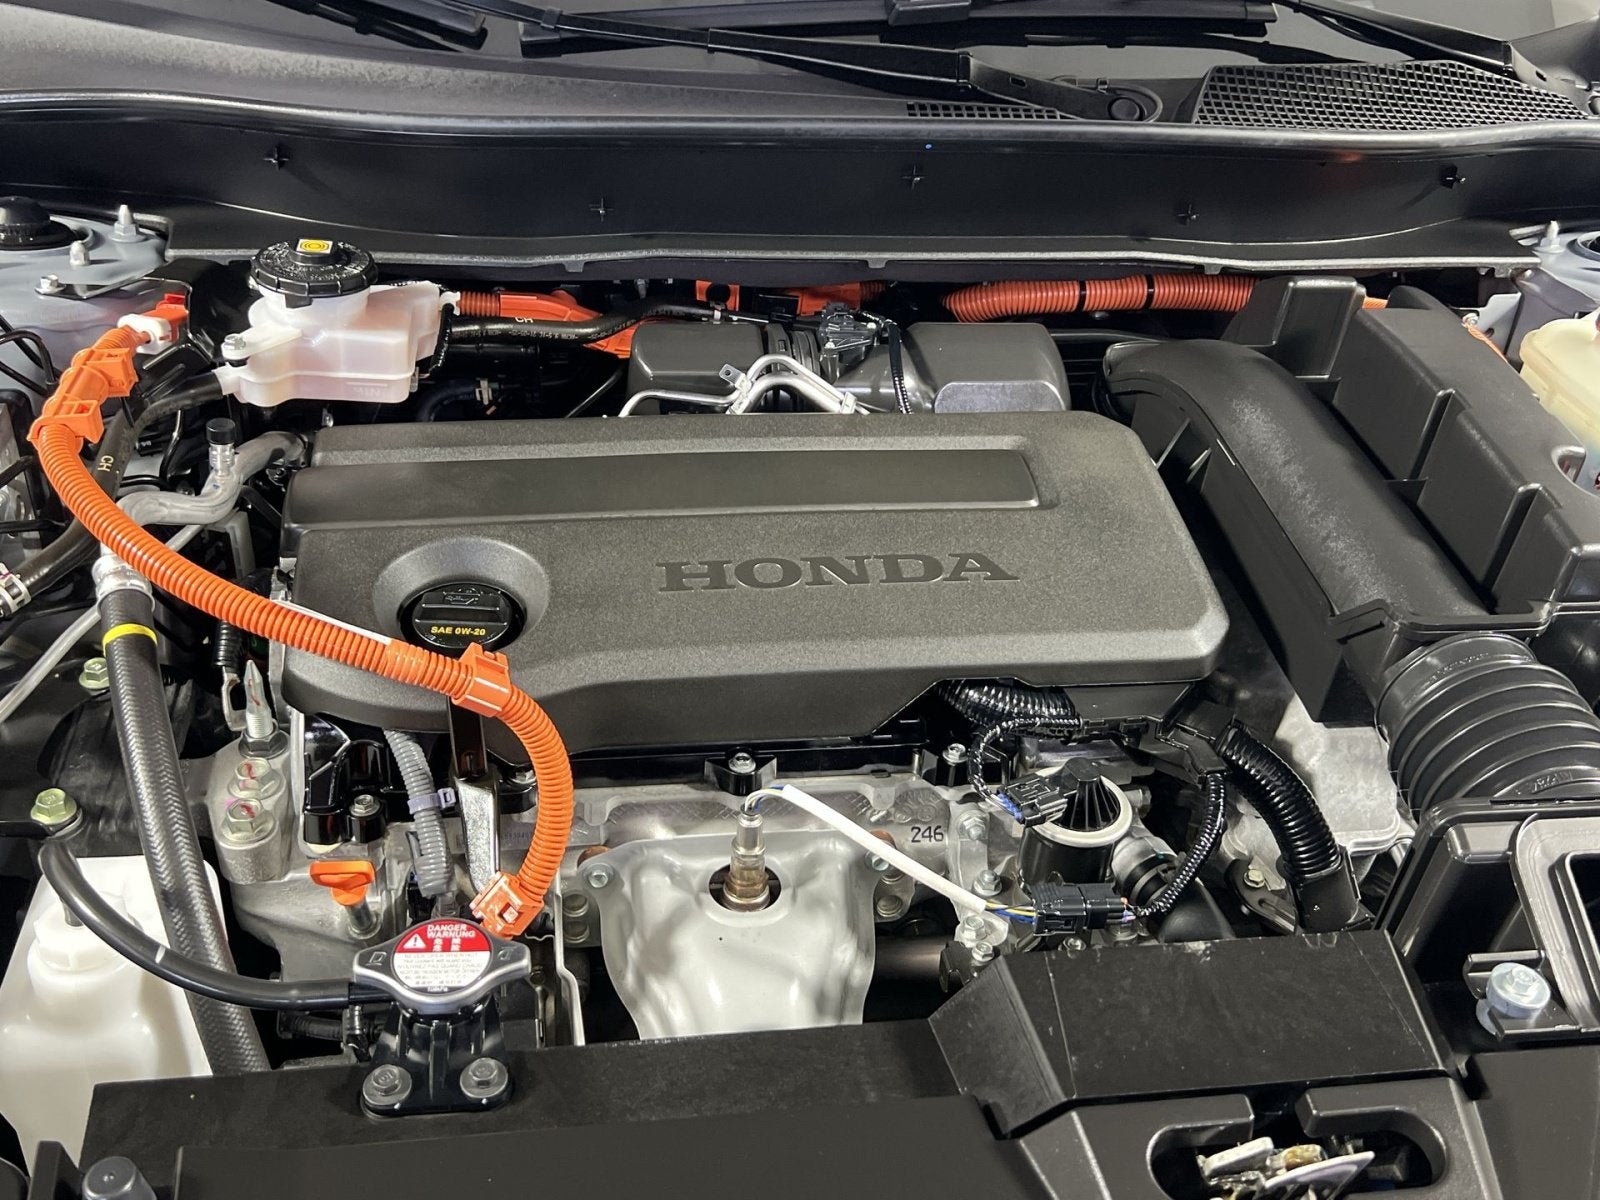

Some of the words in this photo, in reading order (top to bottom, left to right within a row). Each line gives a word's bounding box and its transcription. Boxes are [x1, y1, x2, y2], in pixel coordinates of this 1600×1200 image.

[97, 455, 114, 472] CH
[655, 552, 1020, 593] HONDA
[430, 626, 453, 635] SAE
[454, 627, 486, 636] 0W-20
[910, 825, 944, 843] 246
[427, 923, 468, 932] DANGER
[427, 930, 476, 939] WARNUNG
